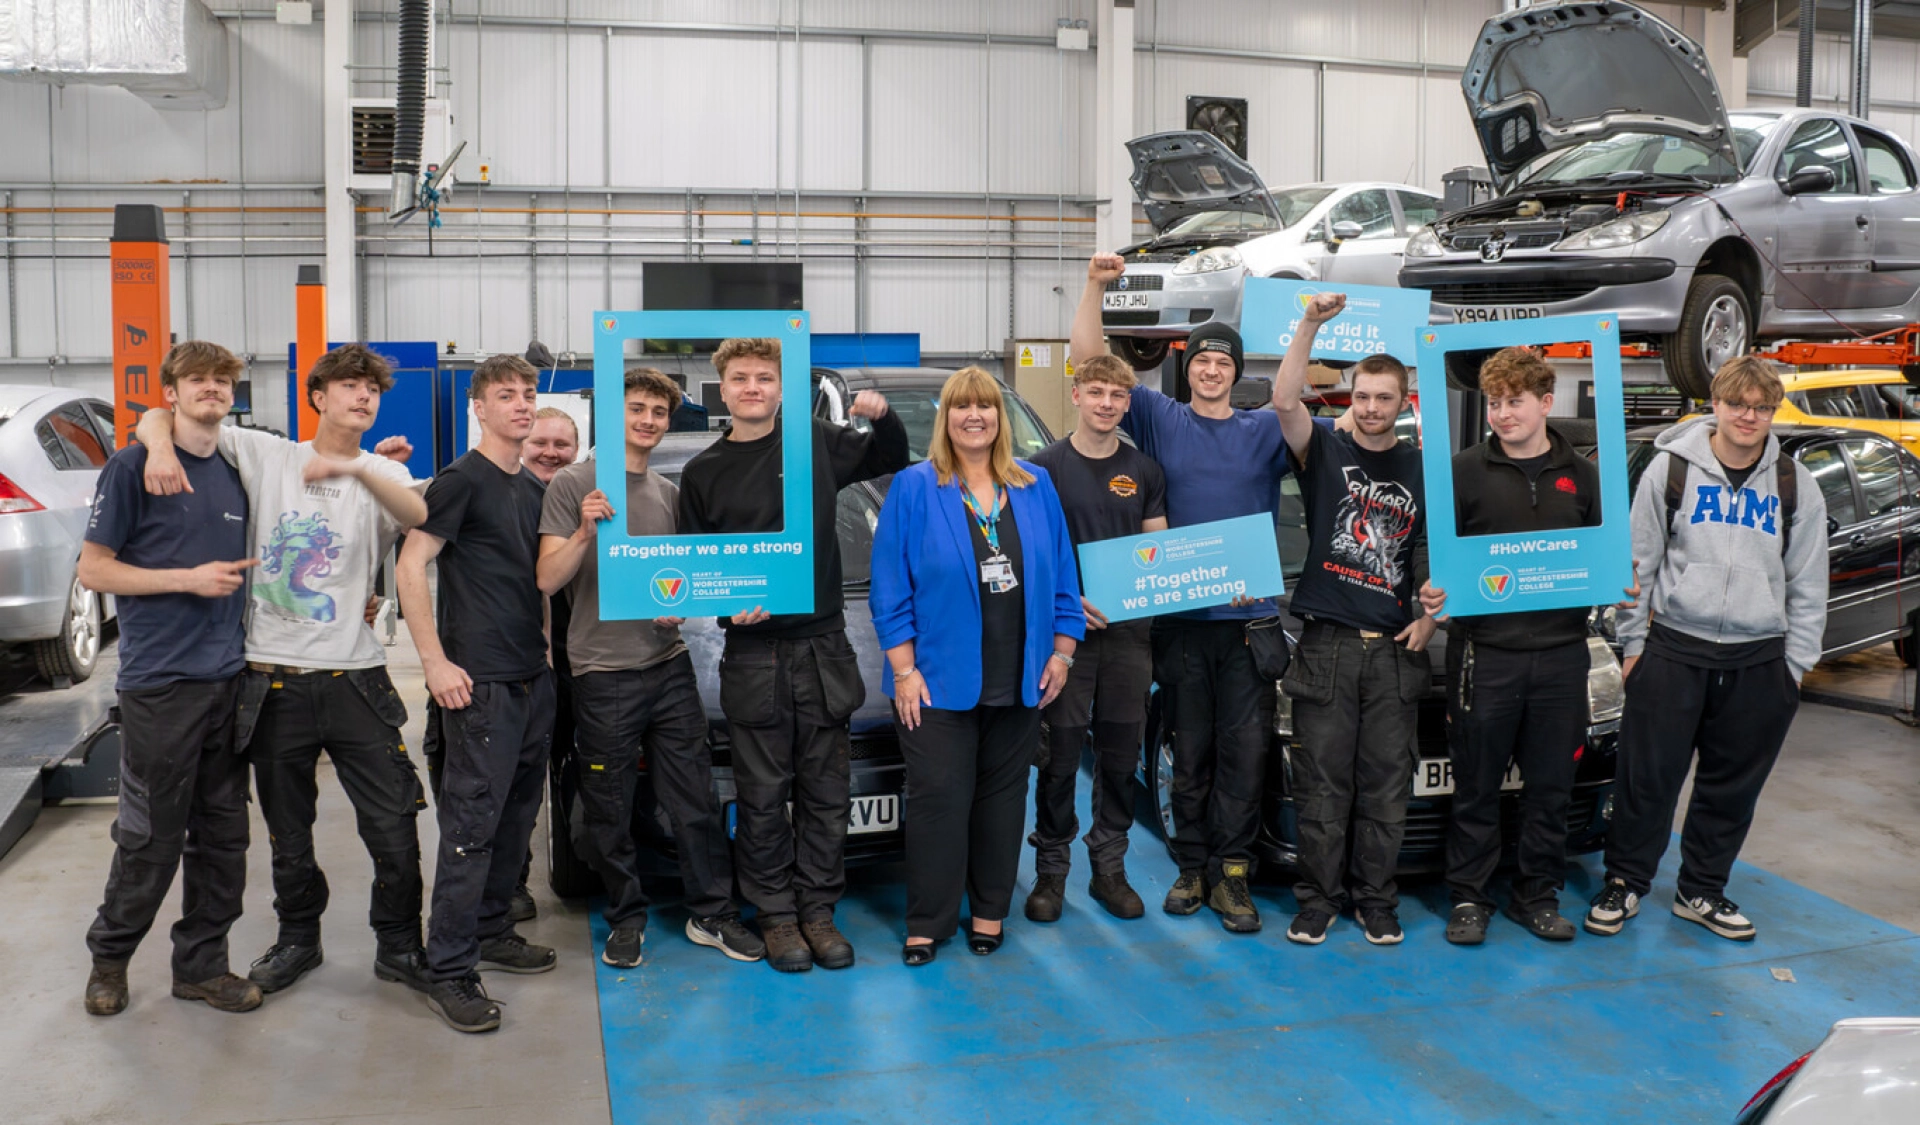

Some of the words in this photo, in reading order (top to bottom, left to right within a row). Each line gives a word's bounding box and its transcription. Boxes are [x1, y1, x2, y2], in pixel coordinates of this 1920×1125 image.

[1105, 294, 1126, 307] MJ57
[1129, 293, 1147, 306] JHU
[1453, 308, 1498, 324] Y994
[1333, 322, 1361, 337] did
[1366, 323, 1379, 339] it
[1341, 338, 1386, 354] 2026
[609, 542, 692, 559] #Together
[696, 544, 719, 555] we
[723, 543, 748, 555] are
[753, 541, 803, 555] strong
[1165, 538, 1224, 553] WORCESTERSHIRE
[1489, 539, 1578, 555] #HoWCares
[1165, 549, 1196, 560] COLLEGE
[1135, 565, 1229, 592] #Together
[1323, 561, 1365, 581] CAUSE
[1367, 575, 1385, 585] OF
[1518, 571, 1588, 583] WORCESTERSHIRE
[692, 578, 768, 588] WORCESTERSHIRE
[1518, 582, 1554, 591] COLLEGE
[692, 587, 731, 596] COLLEGE
[1122, 595, 1149, 610] we
[1153, 590, 1183, 606] are
[1187, 578, 1247, 600] strong
